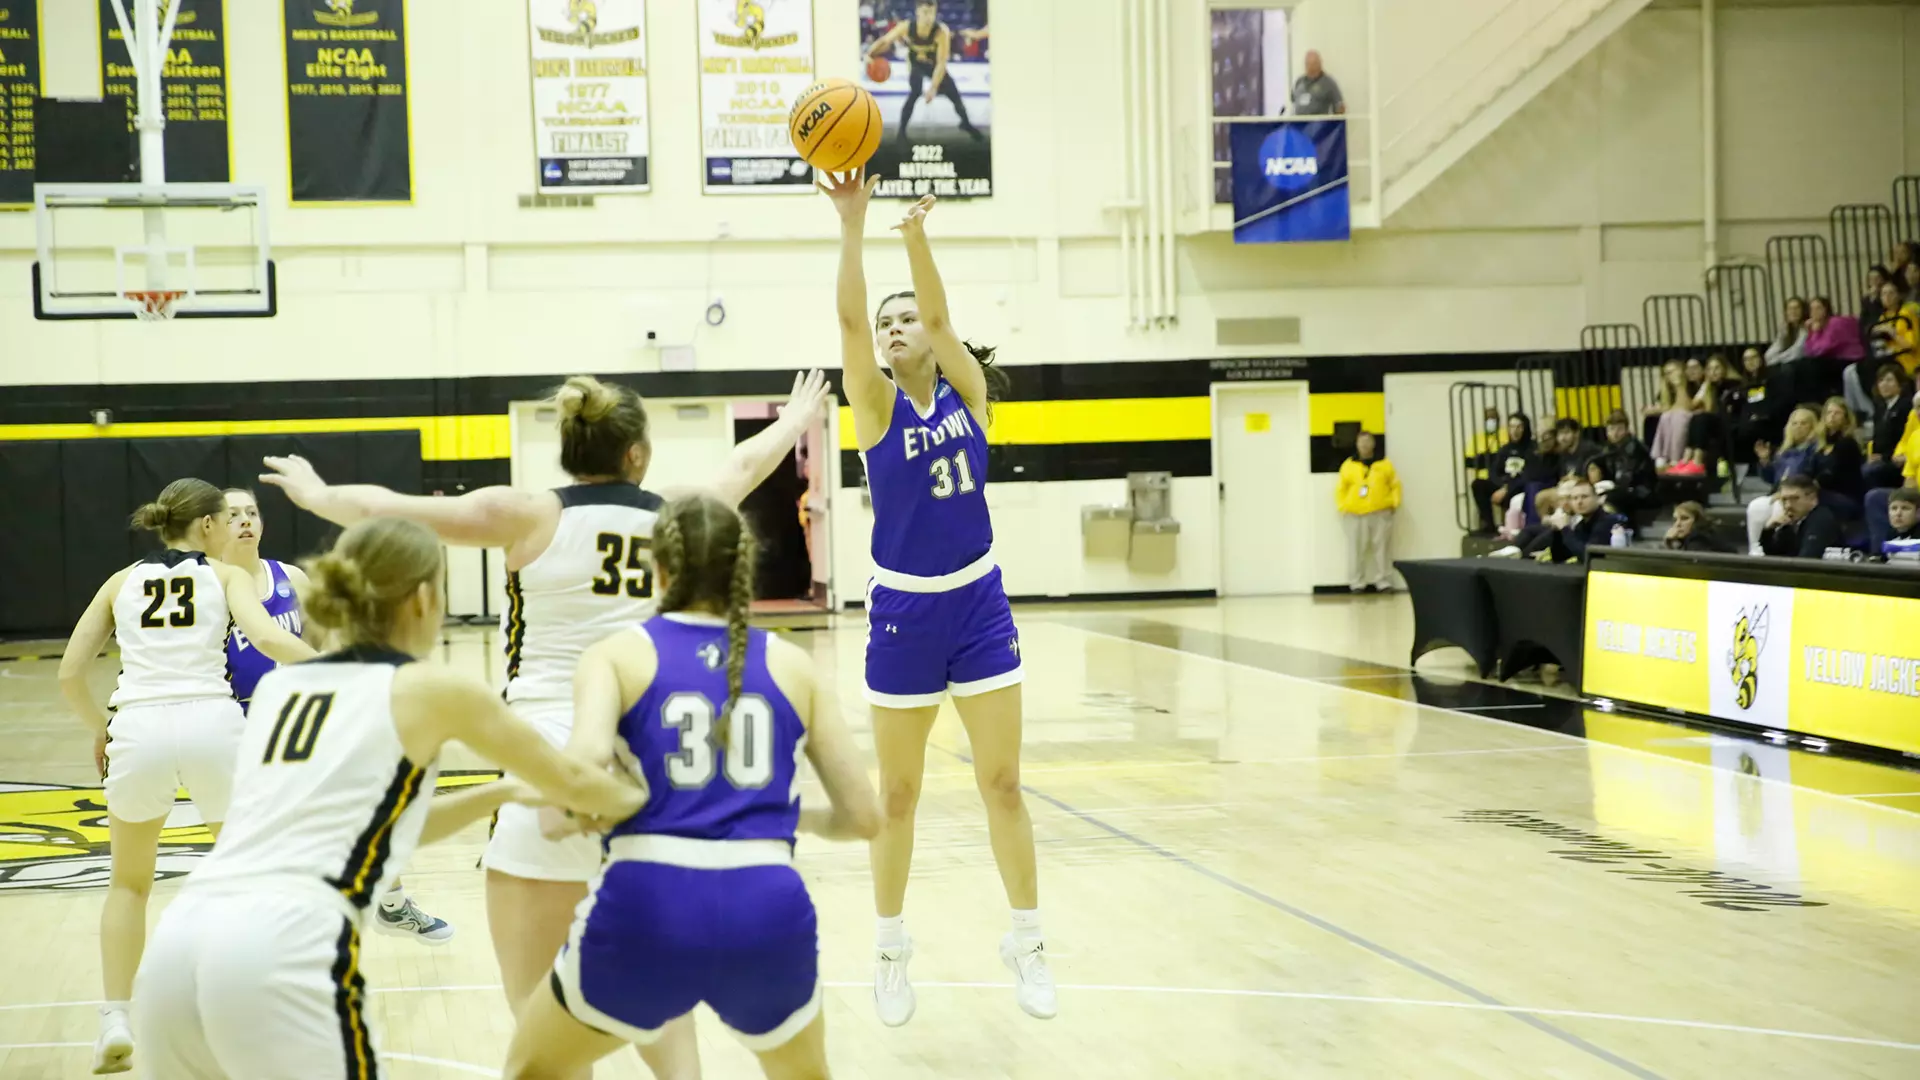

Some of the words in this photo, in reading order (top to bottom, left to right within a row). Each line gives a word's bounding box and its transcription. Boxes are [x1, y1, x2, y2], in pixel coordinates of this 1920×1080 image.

[292, 30, 328, 40] MEN'S
[329, 30, 397, 40] BASKETBALL
[317, 48, 374, 65] NCAA
[306, 63, 342, 77] Elite
[345, 64, 387, 80] Eight
[565, 83, 610, 98] 1977
[735, 81, 780, 95] 2010
[557, 101, 627, 114] NCAA
[729, 98, 786, 111] NCAA
[798, 102, 832, 142] NCAA
[551, 131, 628, 153] FINALIST
[706, 127, 762, 148] FINAL
[912, 145, 943, 161] 2022
[899, 162, 957, 178] NATIONAL
[1265, 157, 1318, 176] NCAA
[914, 179, 931, 195] OF
[933, 179, 957, 195] THE
[958, 178, 990, 195] YEAR
[1265, 369, 1293, 378] ROOM
[929, 448, 976, 500] 31
[592, 532, 653, 598] 35
[141, 576, 195, 628] 23
[233, 608, 302, 652] EWN
[1596, 620, 1642, 655] YELLOW
[1643, 626, 1697, 664] JACKETS
[1804, 645, 1866, 688] YELLOW
[1869, 653, 1920, 698] JACKE
[262, 692, 336, 765] 10
[660, 690, 775, 790] 30
